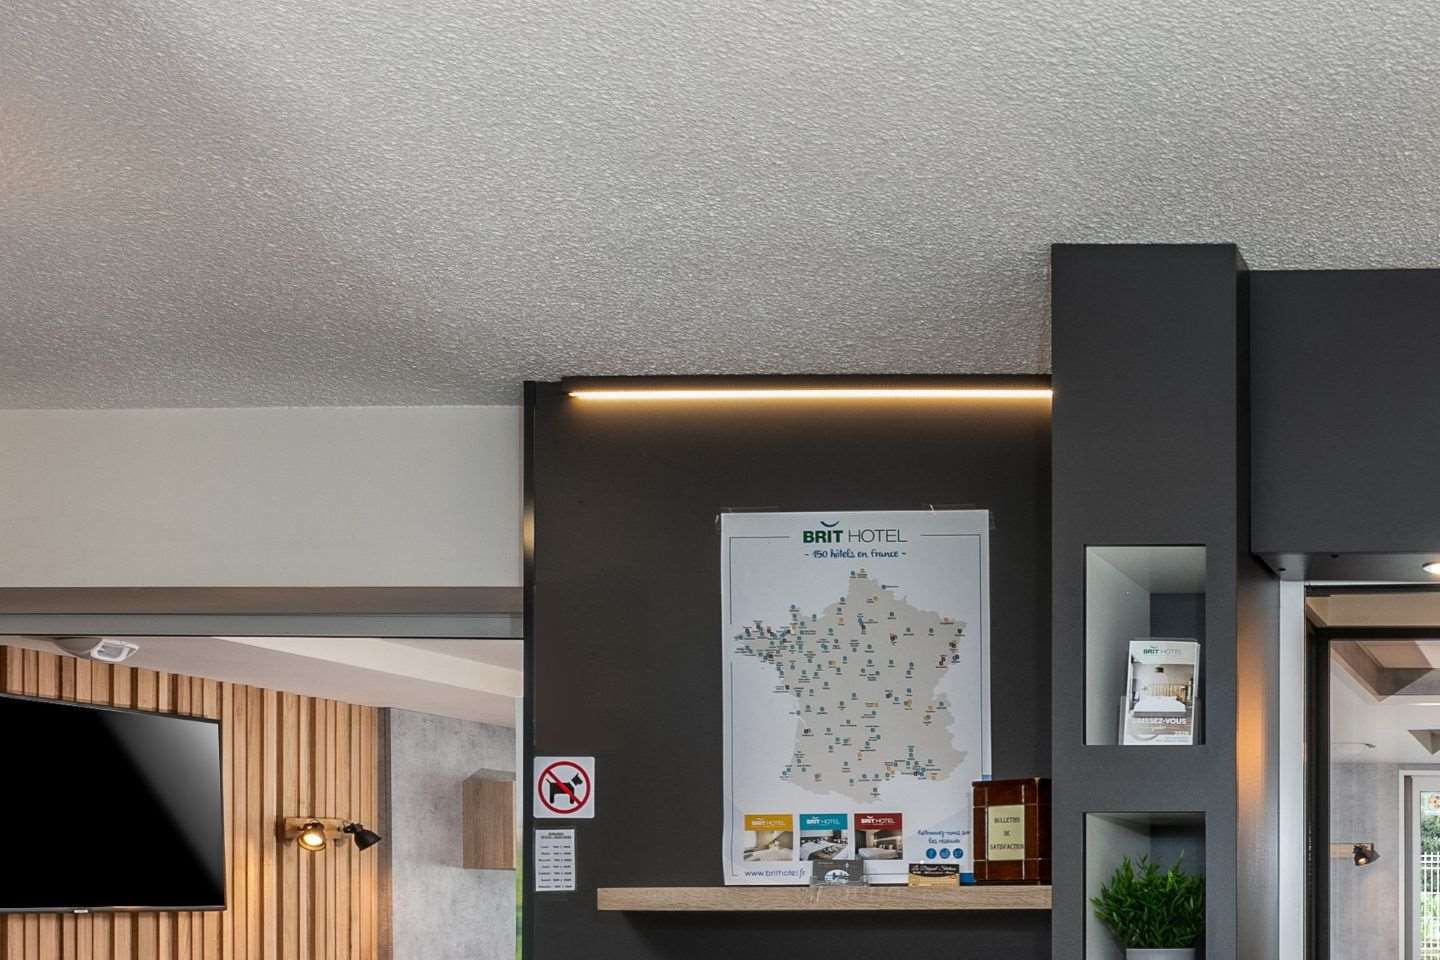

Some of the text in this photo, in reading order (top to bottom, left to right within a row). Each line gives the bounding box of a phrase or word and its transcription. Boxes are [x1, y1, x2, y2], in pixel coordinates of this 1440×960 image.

[802, 528, 908, 543] BRIT HOTEL
[813, 549, 828, 559] 150
